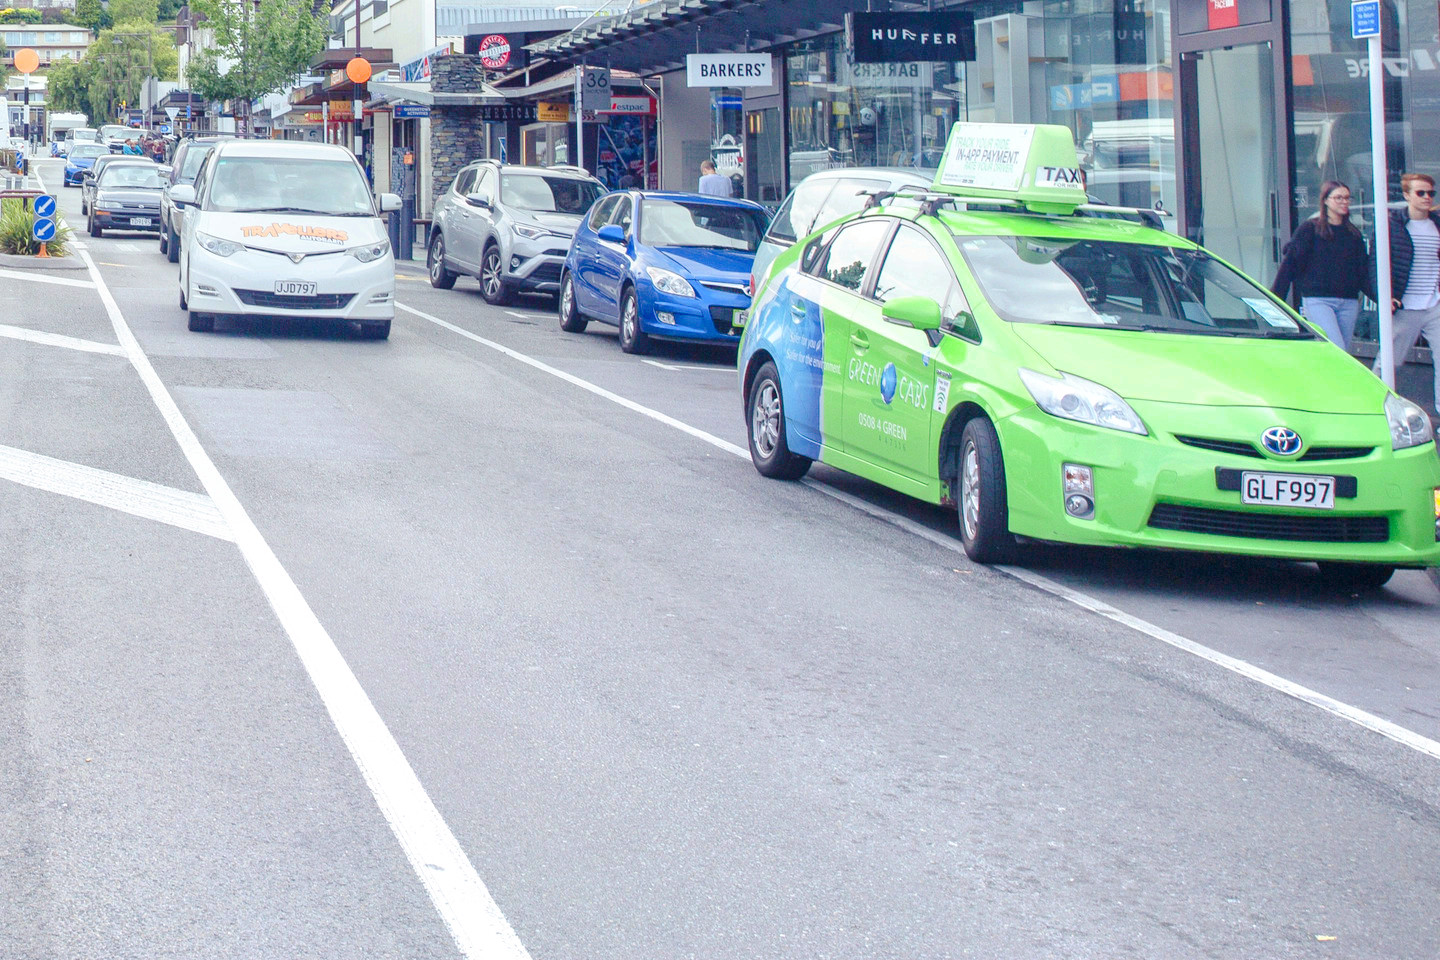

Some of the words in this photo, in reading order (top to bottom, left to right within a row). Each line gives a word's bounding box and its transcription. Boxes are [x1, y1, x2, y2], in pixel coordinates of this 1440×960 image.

[1214, 1, 1226, 9] FACE
[872, 28, 957, 44] HUFFER
[701, 63, 761, 77] BARKERS
[586, 73, 608, 88] 36
[955, 149, 981, 161] IN-APP
[981, 149, 1019, 164] PAYMENT.
[276, 282, 316, 295] JJD797
[848, 357, 882, 387] GREEN
[899, 376, 929, 410] CABS
[858, 412, 875, 430] 0508
[876, 418, 882, 431] 4
[883, 420, 907, 441] GREEN
[1246, 478, 1331, 504] GLF997
